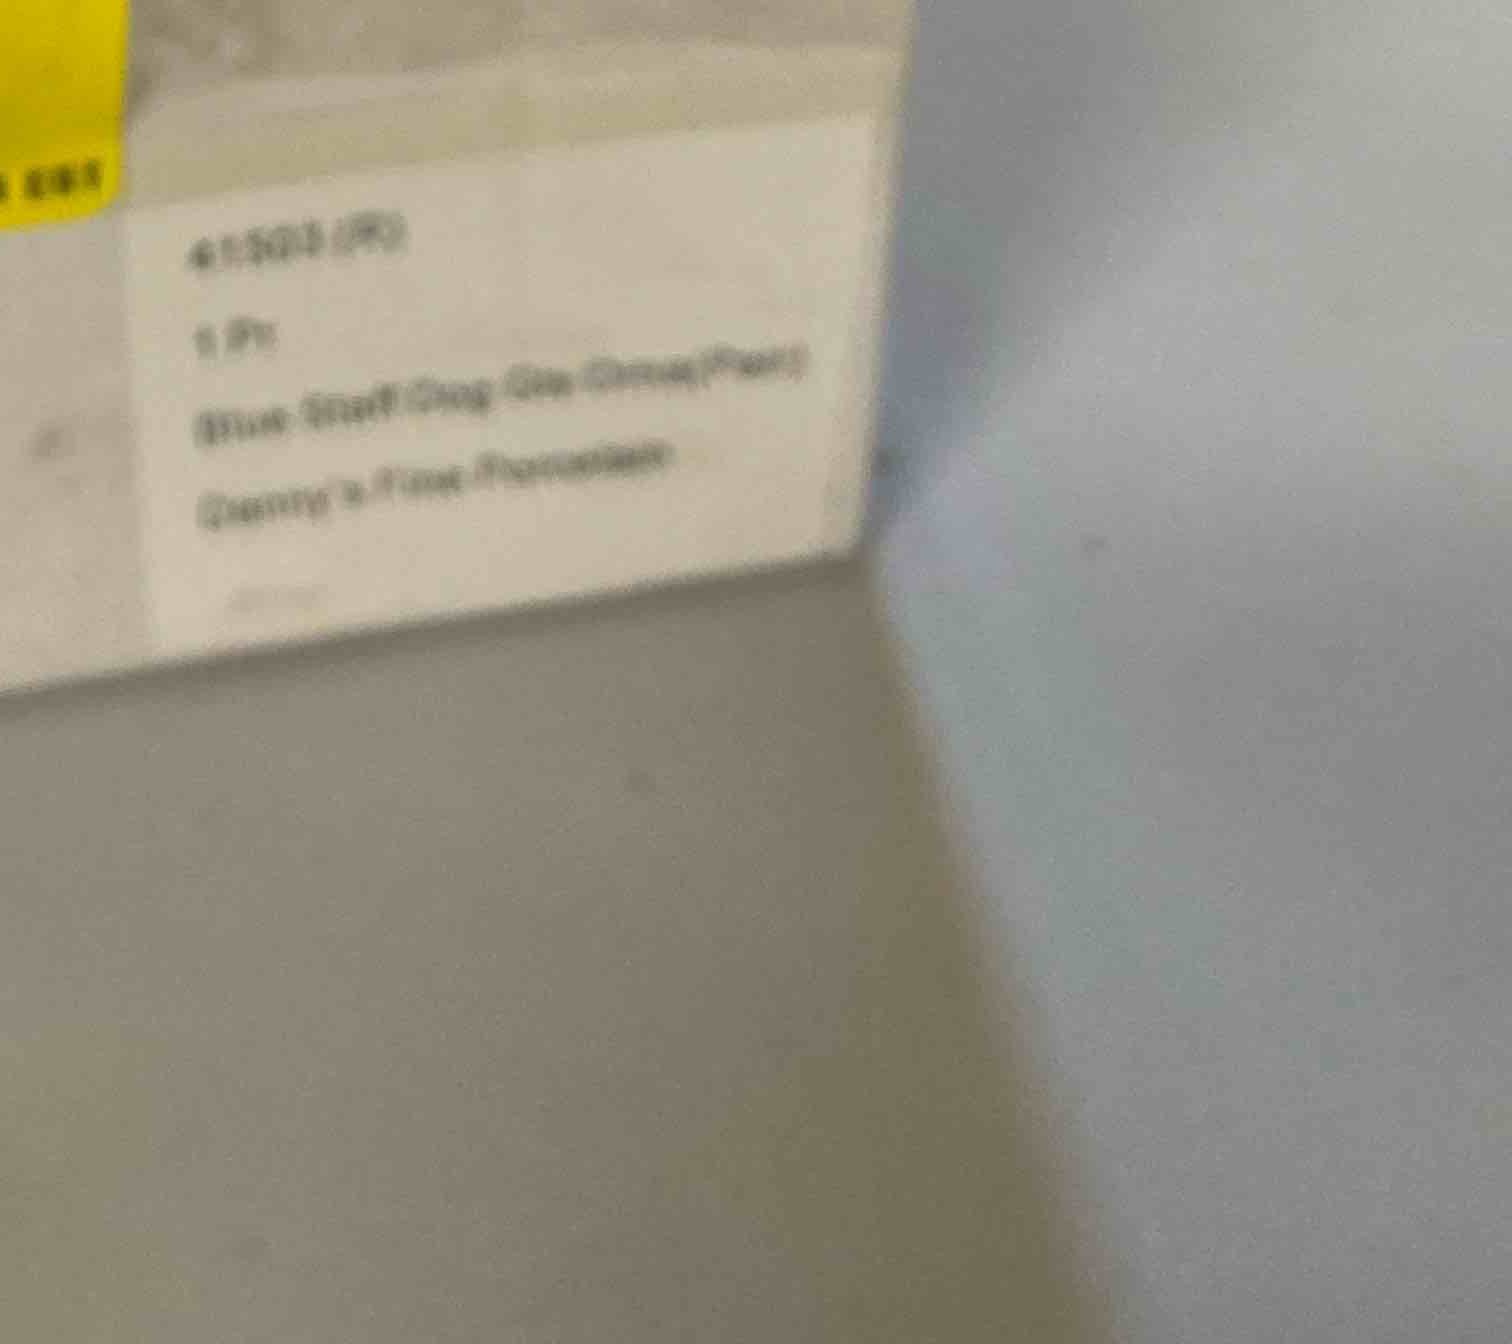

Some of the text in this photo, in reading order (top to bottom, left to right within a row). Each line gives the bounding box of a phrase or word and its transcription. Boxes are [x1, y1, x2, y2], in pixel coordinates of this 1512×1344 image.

[193, 405, 291, 448] Blue
[299, 378, 399, 431] Staff
[402, 373, 493, 417] Dog
[195, 438, 676, 533] Danny's Fine Porcelain
